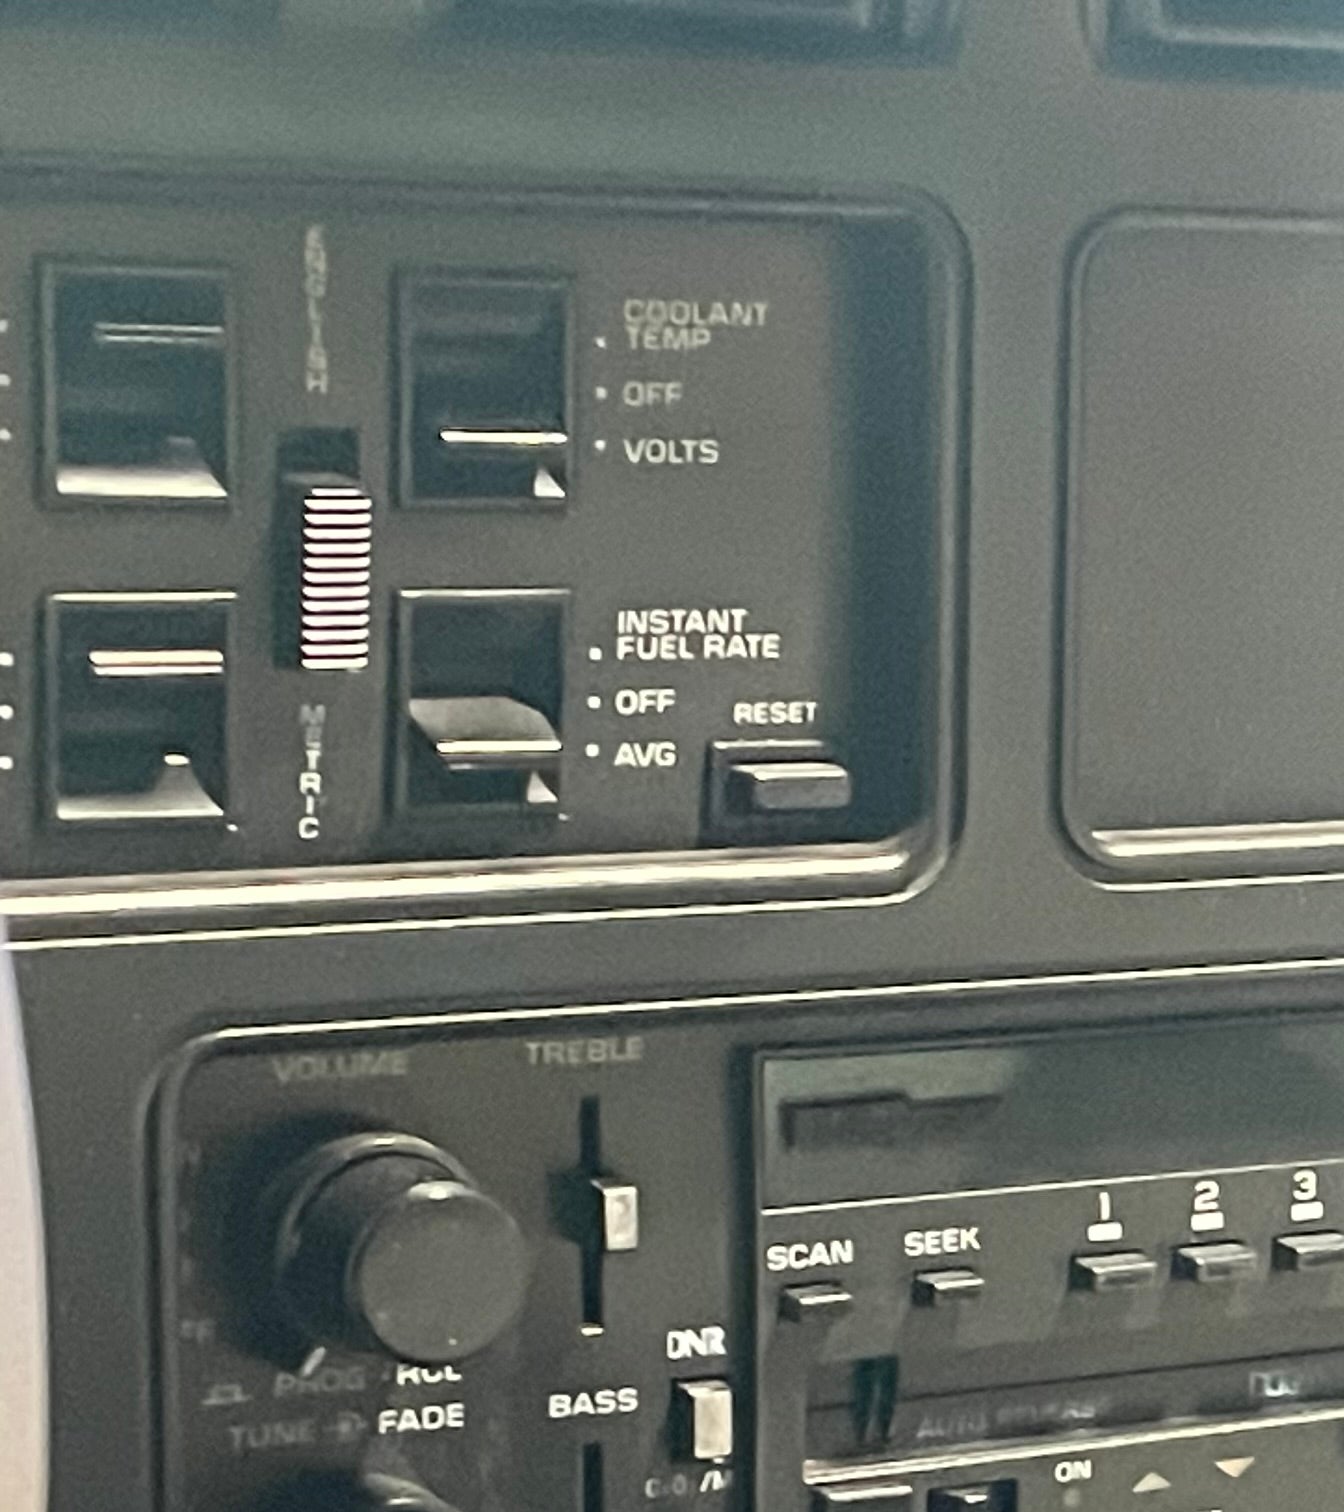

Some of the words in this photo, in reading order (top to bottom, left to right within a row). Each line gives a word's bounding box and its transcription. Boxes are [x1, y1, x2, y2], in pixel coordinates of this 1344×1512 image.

[624, 299, 768, 326] COOLANT
[626, 325, 711, 350] TEMP
[623, 381, 683, 406] OFF
[623, 438, 719, 464] VOLTS
[617, 608, 748, 635] INSTANT
[616, 635, 694, 660] FUEL
[703, 633, 782, 659] RATE
[615, 689, 676, 716] OFF
[733, 701, 818, 725] RESET
[613, 742, 677, 768] AVG
[299, 703, 326, 839] METRIC
[525, 1036, 645, 1065] TREBLE
[271, 1051, 410, 1083] VOLUME
[1099, 1191, 1110, 1221] 1
[1194, 1181, 1219, 1210] 2
[1292, 1168, 1317, 1201] 3
[904, 1225, 981, 1257] SEEK
[766, 1239, 854, 1272] SCAN
[666, 1325, 727, 1360] DNR
[549, 1387, 638, 1418] BASS
[378, 1402, 465, 1435] FADE
[1054, 1460, 1091, 1482] ON
